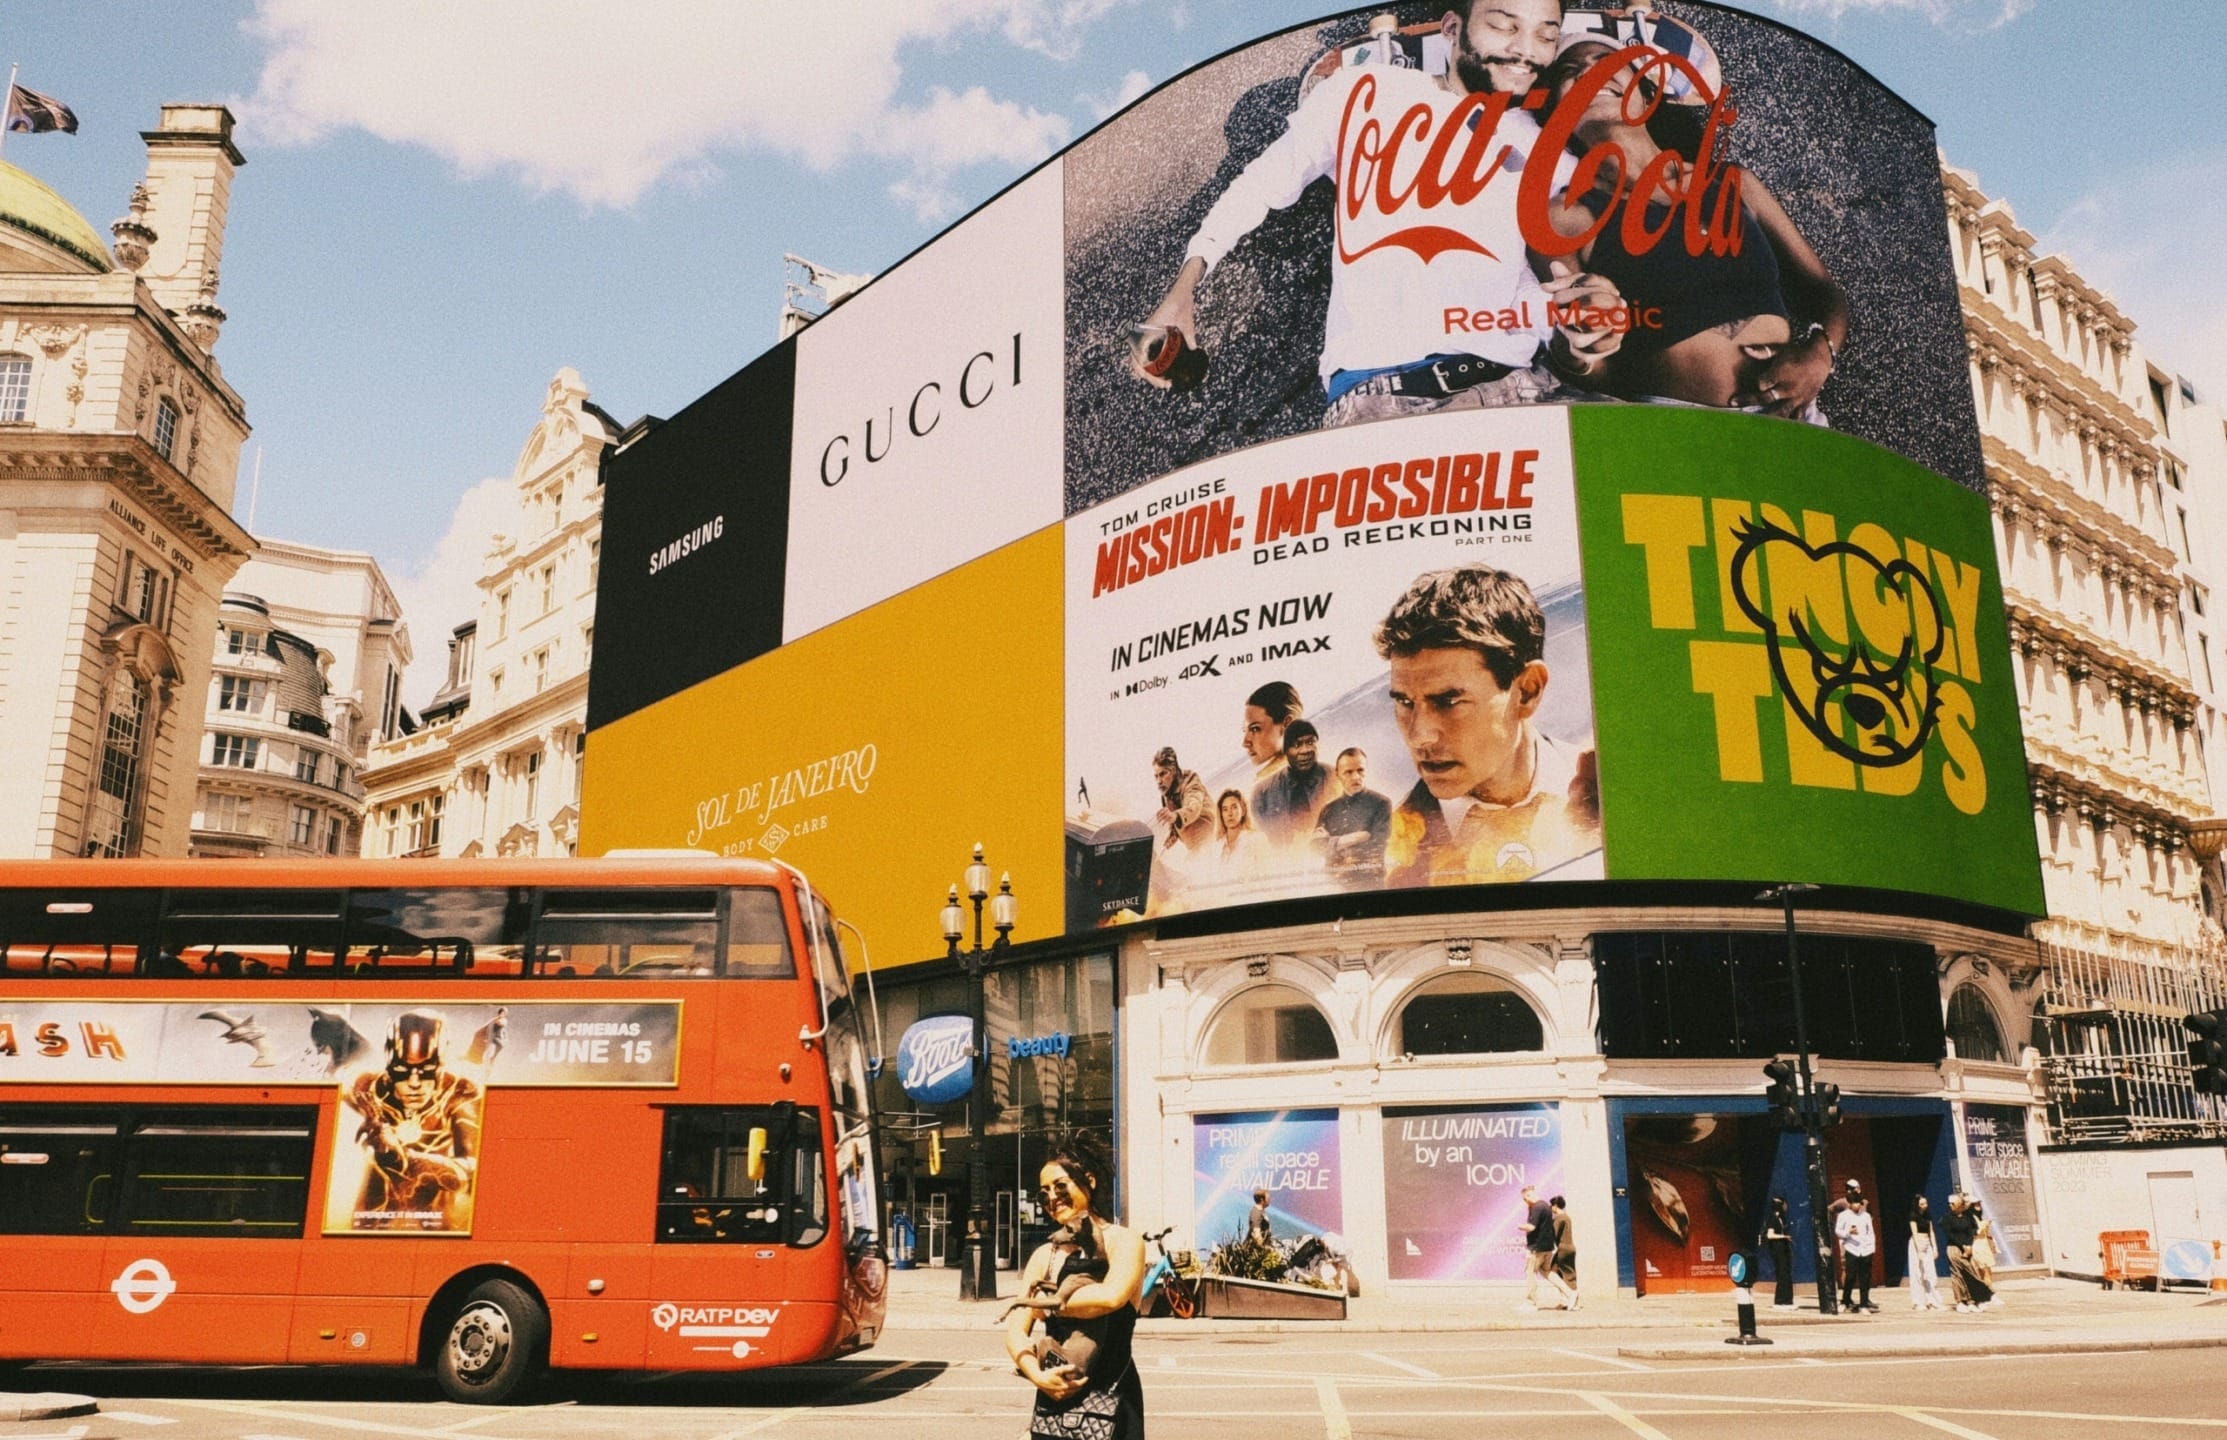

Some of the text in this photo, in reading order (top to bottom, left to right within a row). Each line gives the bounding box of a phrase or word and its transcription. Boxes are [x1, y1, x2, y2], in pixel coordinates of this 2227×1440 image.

[1335, 44, 1744, 265] Coca-Cola
[1443, 299, 1664, 335] Real Magic
[820, 332, 1022, 487] GUCCI
[1101, 478, 1227, 536] TOM CRUISE
[109, 498, 194, 574] ALLIANCE LIFE OFFICE
[1093, 450, 1539, 599] MISSION: IMPOSSIBLE
[649, 515, 724, 576] SAMSUNG
[1254, 514, 1532, 565] DEAD RECKONING
[1455, 534, 1533, 546] PART ONE
[1620, 494, 1981, 685] TINGLY
[1111, 592, 1333, 672] IN CINEMAS NOW
[1110, 690, 1120, 701] IN
[1178, 654, 1222, 680] 4DX
[1228, 653, 1253, 667] AND
[1261, 635, 1332, 662] IMAX
[687, 793, 732, 847] SOL
[735, 782, 762, 814] DE
[758, 743, 877, 825] JANEIRO
[723, 838, 753, 858] BODY
[793, 815, 828, 836] CARE
[1102, 896, 1139, 912] SKYDANCE
[543, 1022, 640, 1036] IN CINEMAS
[528, 1039, 653, 1064] JUNE 15
[1008, 1031, 1072, 1059] beauty
[1402, 1116, 1551, 1141] ILLUMINATED
[1967, 1116, 1998, 1136] PRIME
[1264, 1151, 1320, 1172] space
[1415, 1143, 1472, 1167] by an
[1975, 1139, 2025, 1160] retail space
[1230, 1169, 1331, 1191] AVAILABLE
[1466, 1163, 1525, 1186] ICON
[1984, 1160, 2031, 1179] AVAILABLE
[680, 1308, 733, 1324] RATP
